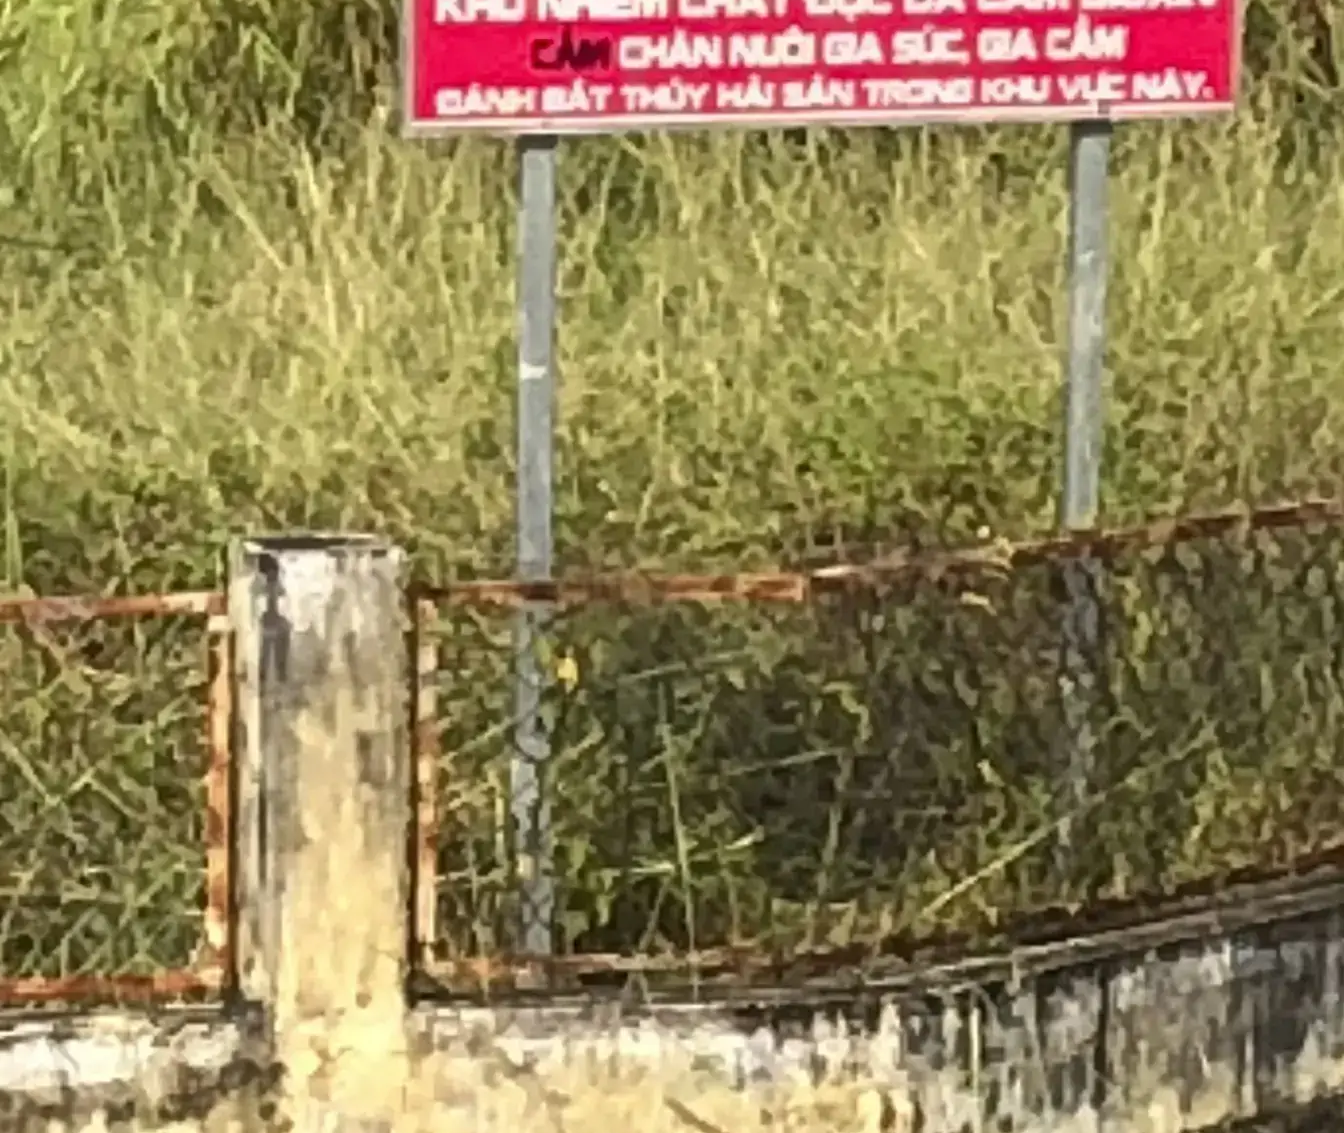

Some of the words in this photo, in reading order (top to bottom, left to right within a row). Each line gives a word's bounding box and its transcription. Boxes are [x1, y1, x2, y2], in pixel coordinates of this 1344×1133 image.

[729, 25, 815, 67] NUÔI
[822, 32, 885, 65] GIA
[977, 27, 1037, 61] GIA
[1045, 13, 1129, 61] CẦM
[435, 82, 535, 115] ĐÁNH
[542, 78, 612, 112] BẮT
[716, 72, 776, 108] HẢI
[782, 73, 854, 107] SẢN
[861, 77, 973, 105] TRONG
[981, 75, 1051, 103] KHU
[1132, 66, 1215, 99] NÀY.
